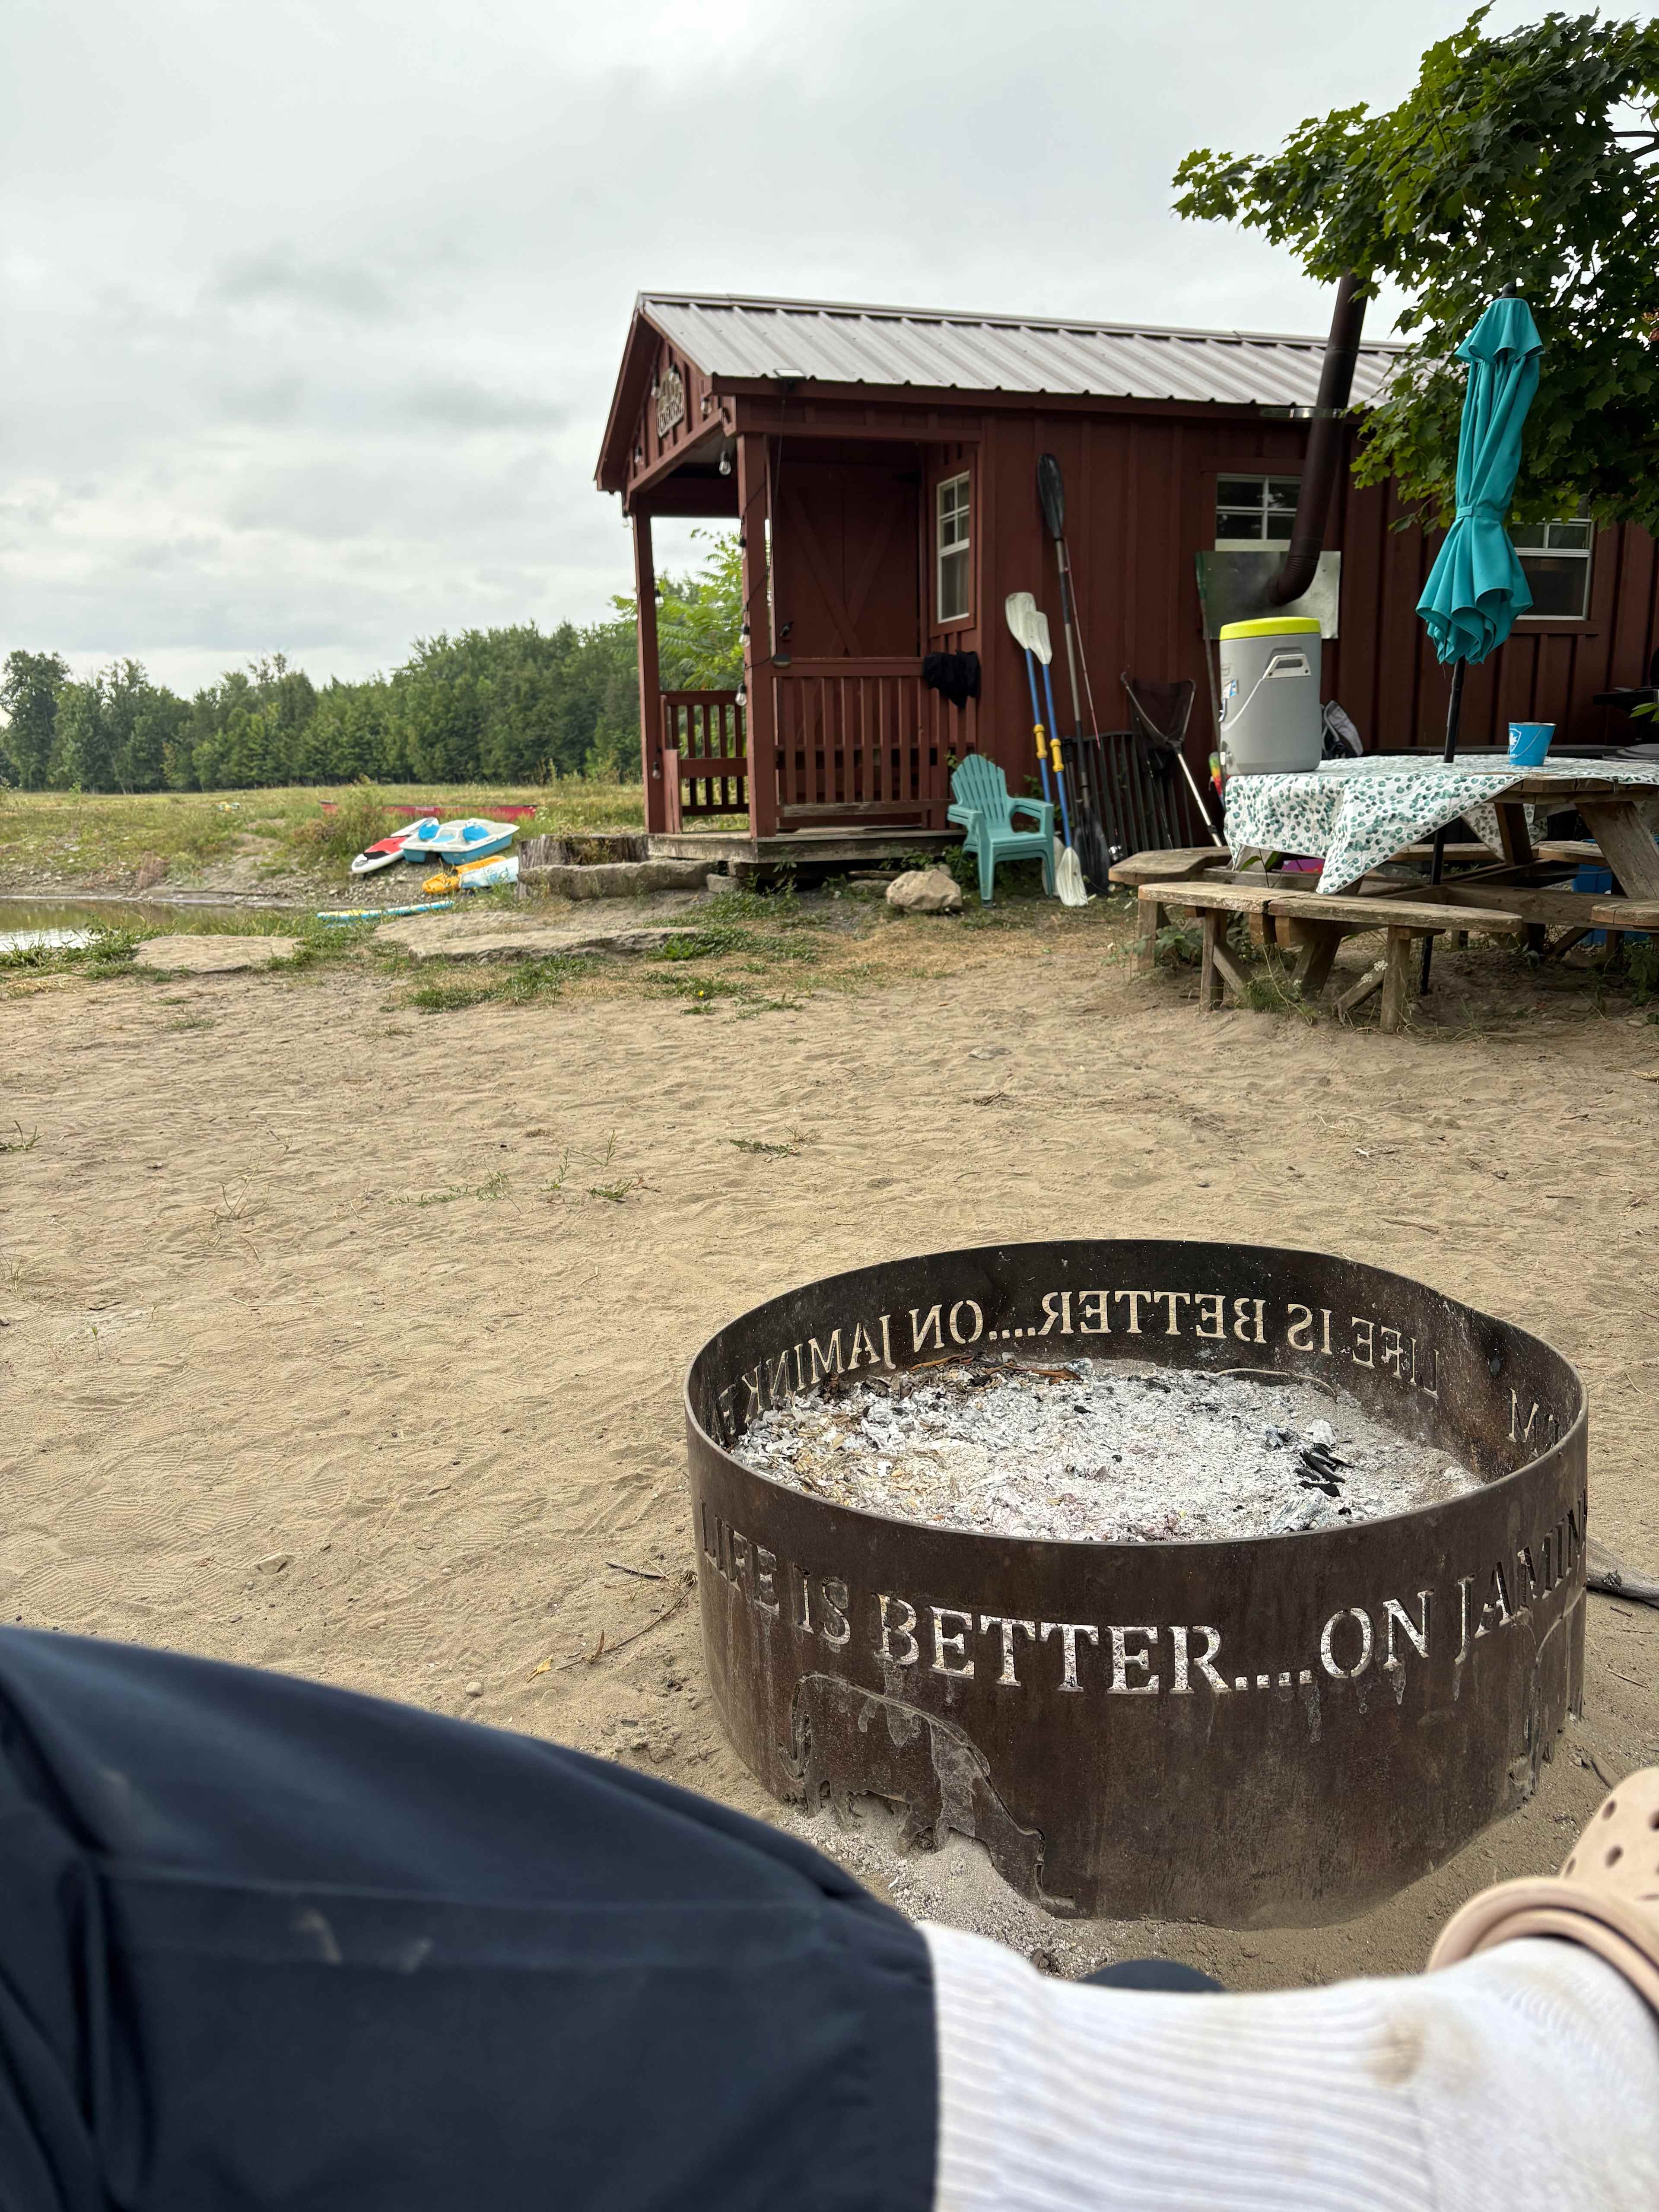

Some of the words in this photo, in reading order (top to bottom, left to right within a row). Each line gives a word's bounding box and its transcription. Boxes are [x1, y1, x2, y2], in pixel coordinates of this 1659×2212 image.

[700, 1497, 780, 1616] LIFE
[793, 1561, 851, 1645] IS
[1454, 1487, 1587, 1666] JAMIN
